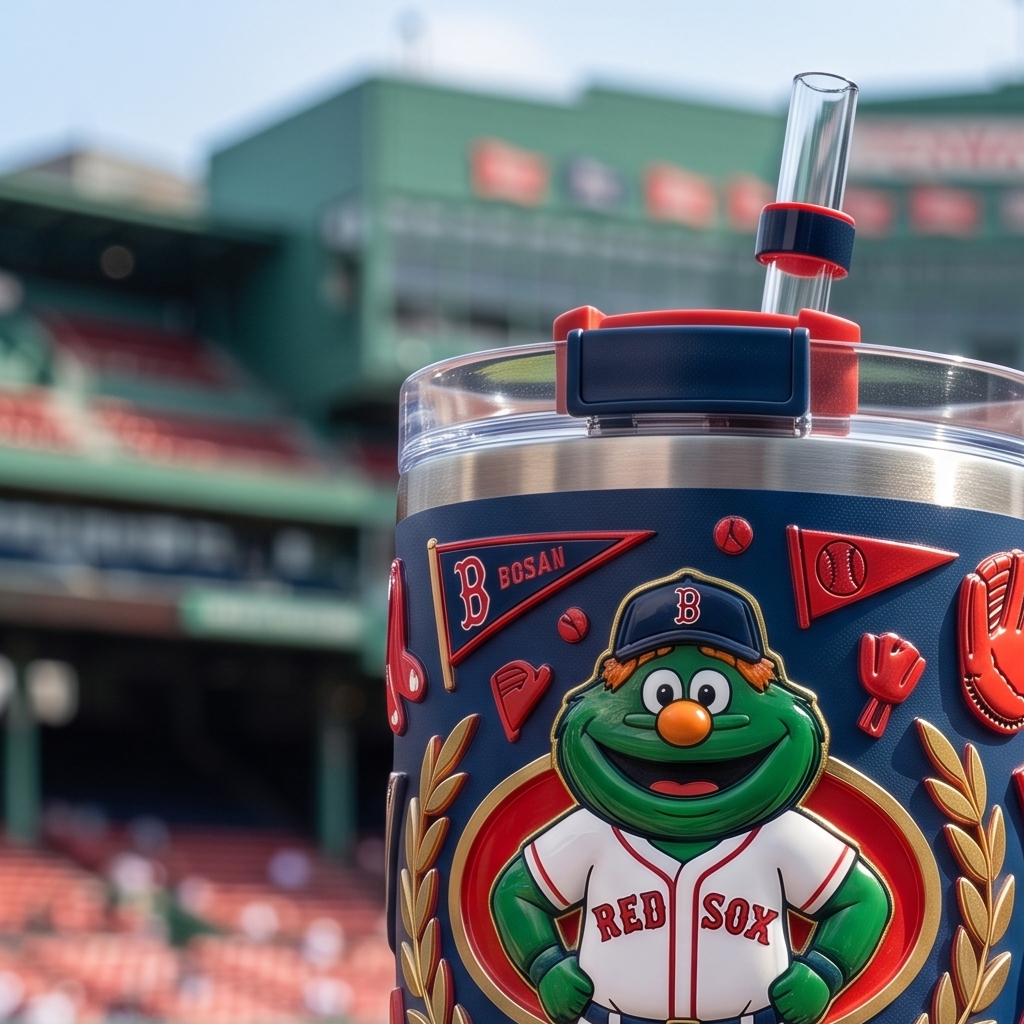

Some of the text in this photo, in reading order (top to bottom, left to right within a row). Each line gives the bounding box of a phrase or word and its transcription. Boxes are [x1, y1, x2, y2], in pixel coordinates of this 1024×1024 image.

[454, 546, 566, 631] B BOSAN
[674, 587, 701, 625] B
[591, 890, 780, 946] RED SOX
